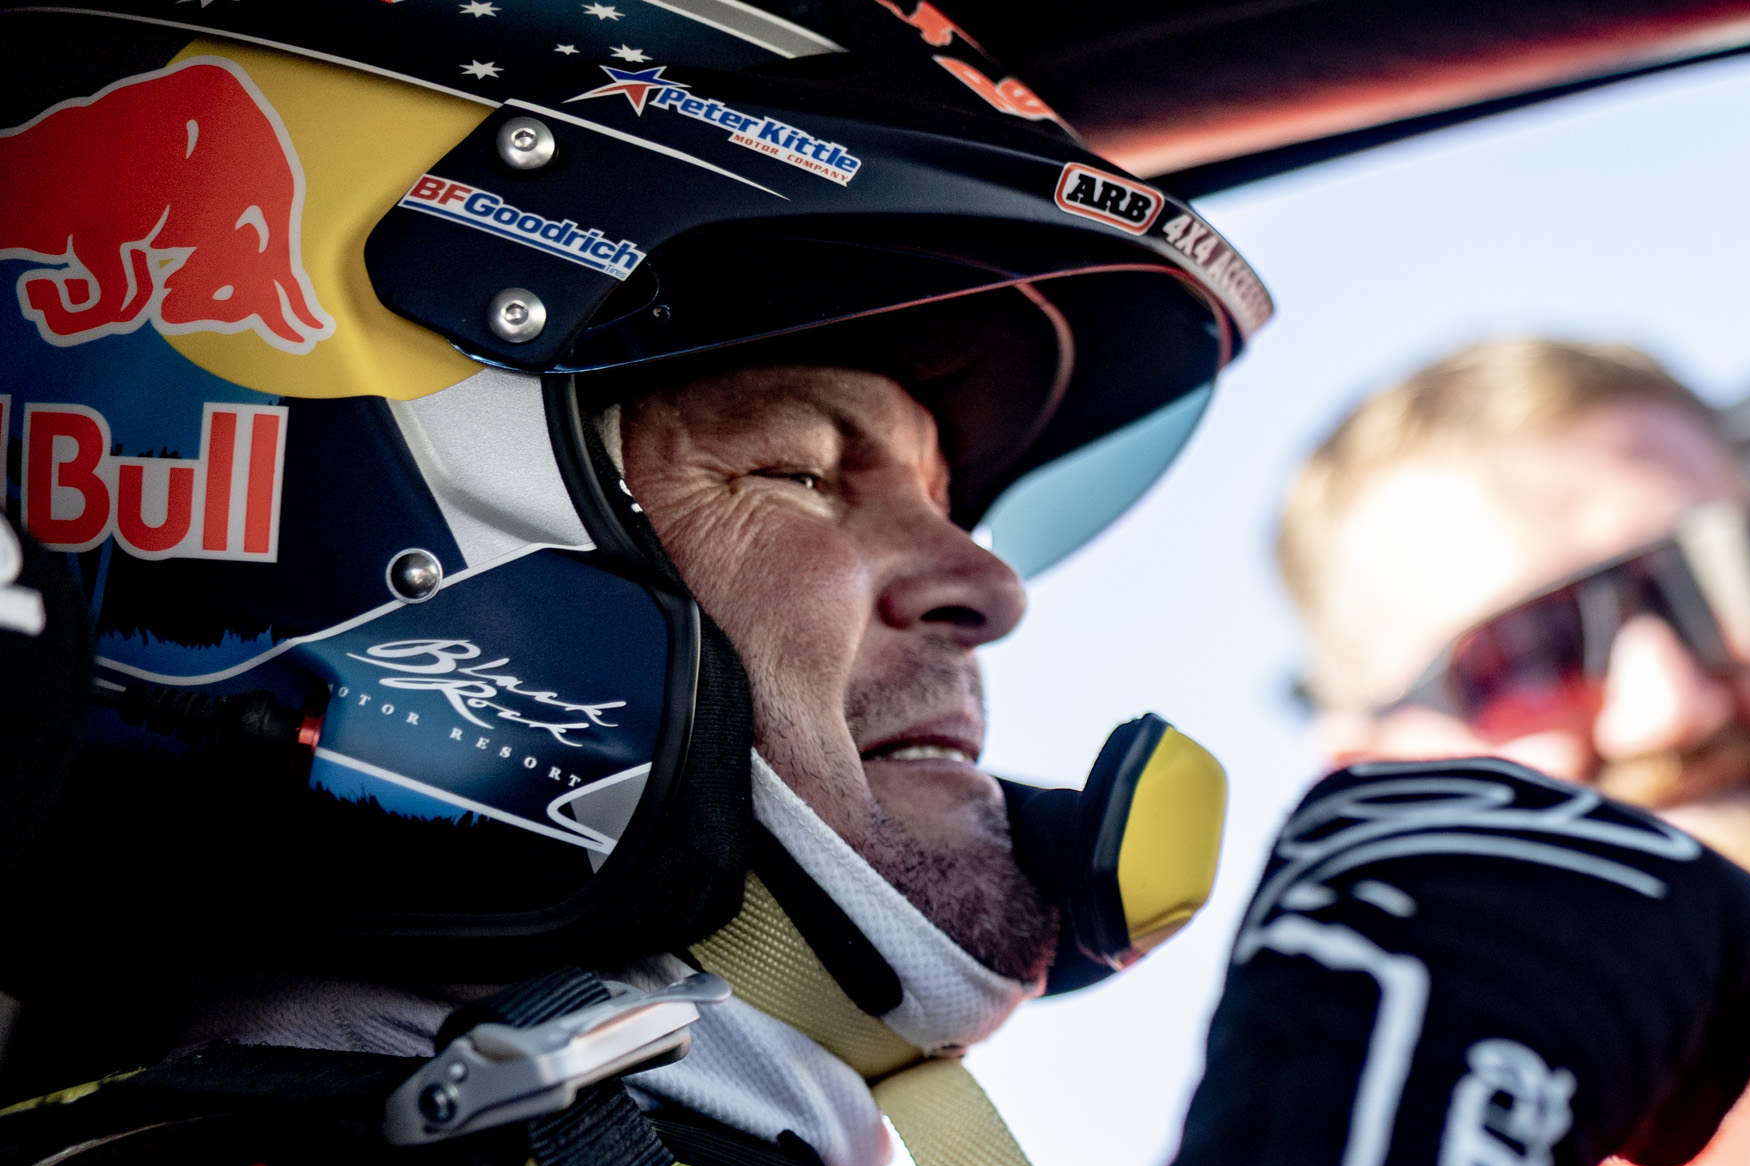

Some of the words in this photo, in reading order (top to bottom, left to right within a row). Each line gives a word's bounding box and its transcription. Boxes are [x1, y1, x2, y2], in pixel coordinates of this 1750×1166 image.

[733, 133, 780, 155] MOTOR
[786, 153, 849, 182] COMPANY
[409, 175, 640, 270] BFGoodrich
[1066, 172, 1153, 224] ARB
[603, 263, 627, 280] Tires
[25, 404, 282, 555] Bull
[346, 638, 628, 728] Black
[378, 677, 590, 748] Rock
[329, 682, 421, 726] OTOR
[449, 727, 582, 788] RESORT
